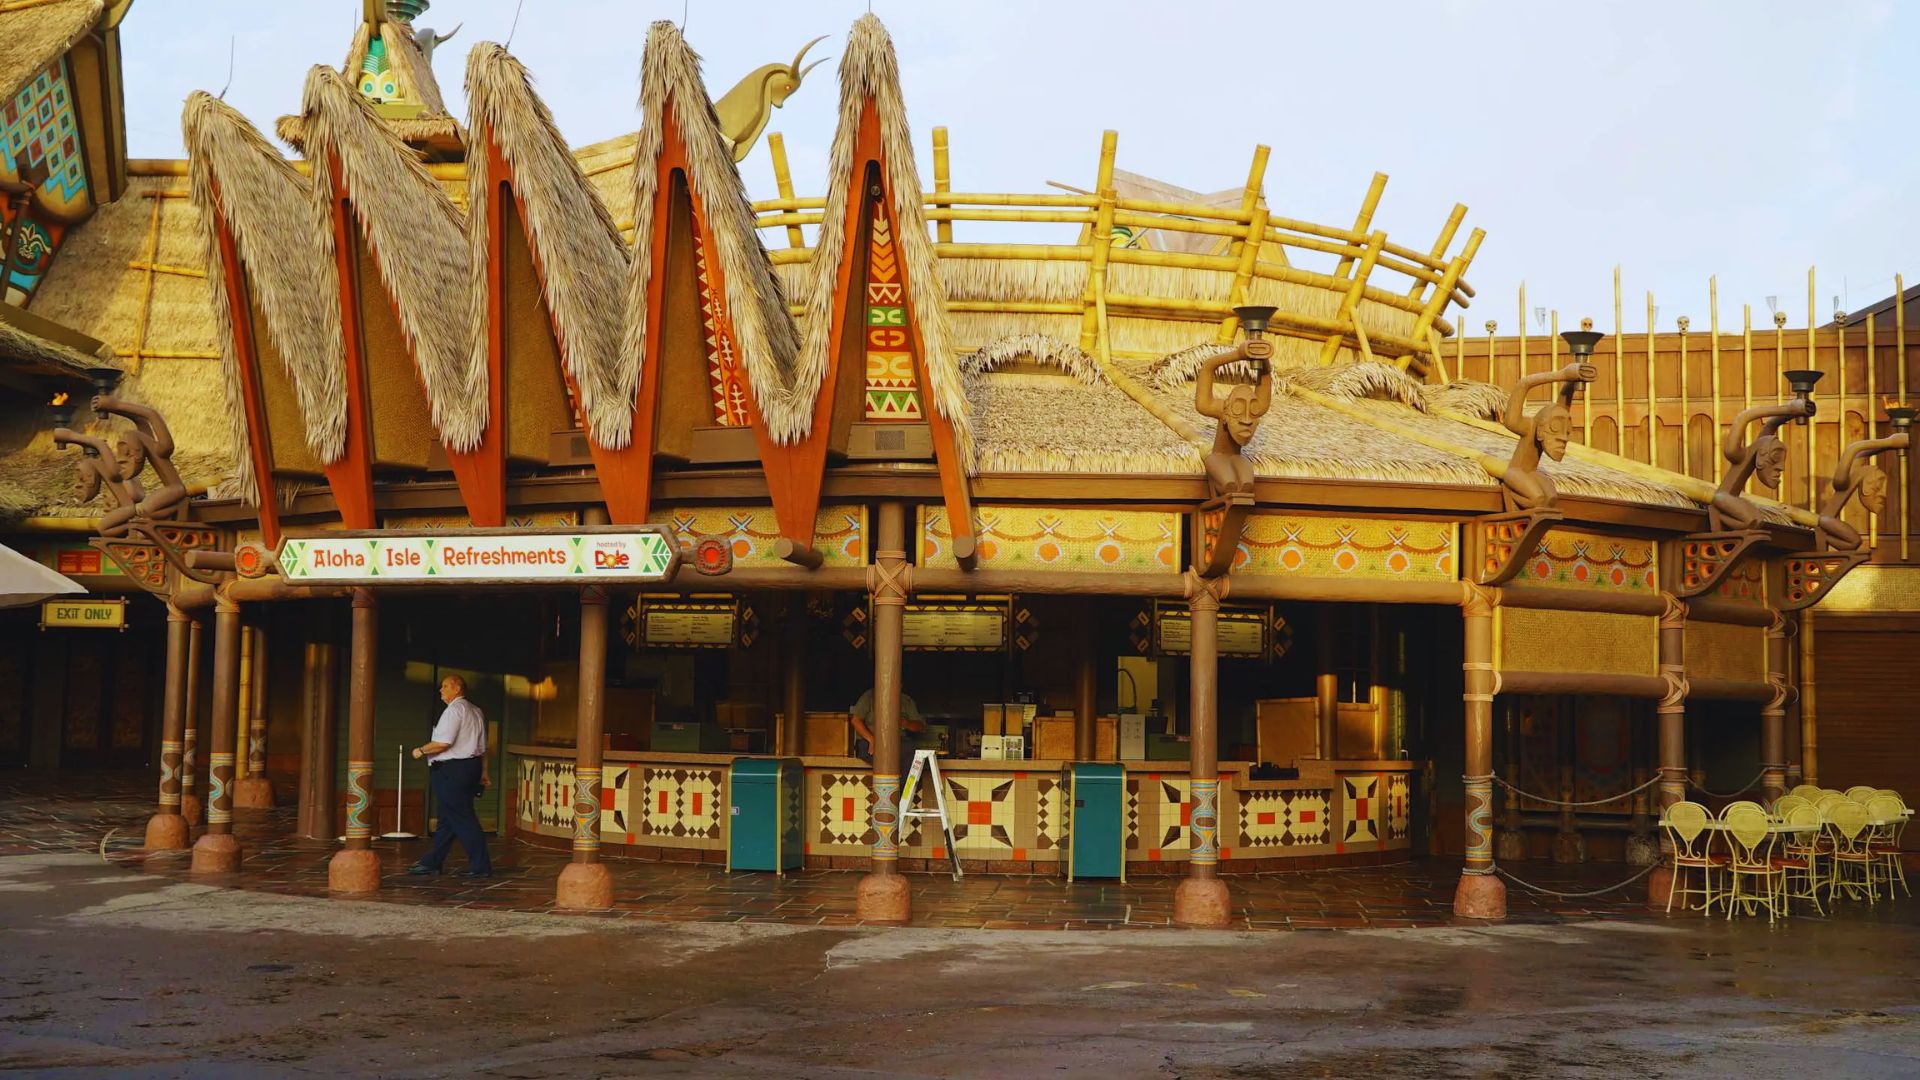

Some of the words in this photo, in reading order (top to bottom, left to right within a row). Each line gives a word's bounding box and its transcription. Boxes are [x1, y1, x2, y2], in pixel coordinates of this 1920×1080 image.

[314, 548, 365, 568] Aloha
[386, 548, 421, 567] Isle
[443, 546, 566, 567] Refreshments
[595, 550, 629, 567] Dole
[84, 608, 111, 620] ONLY
